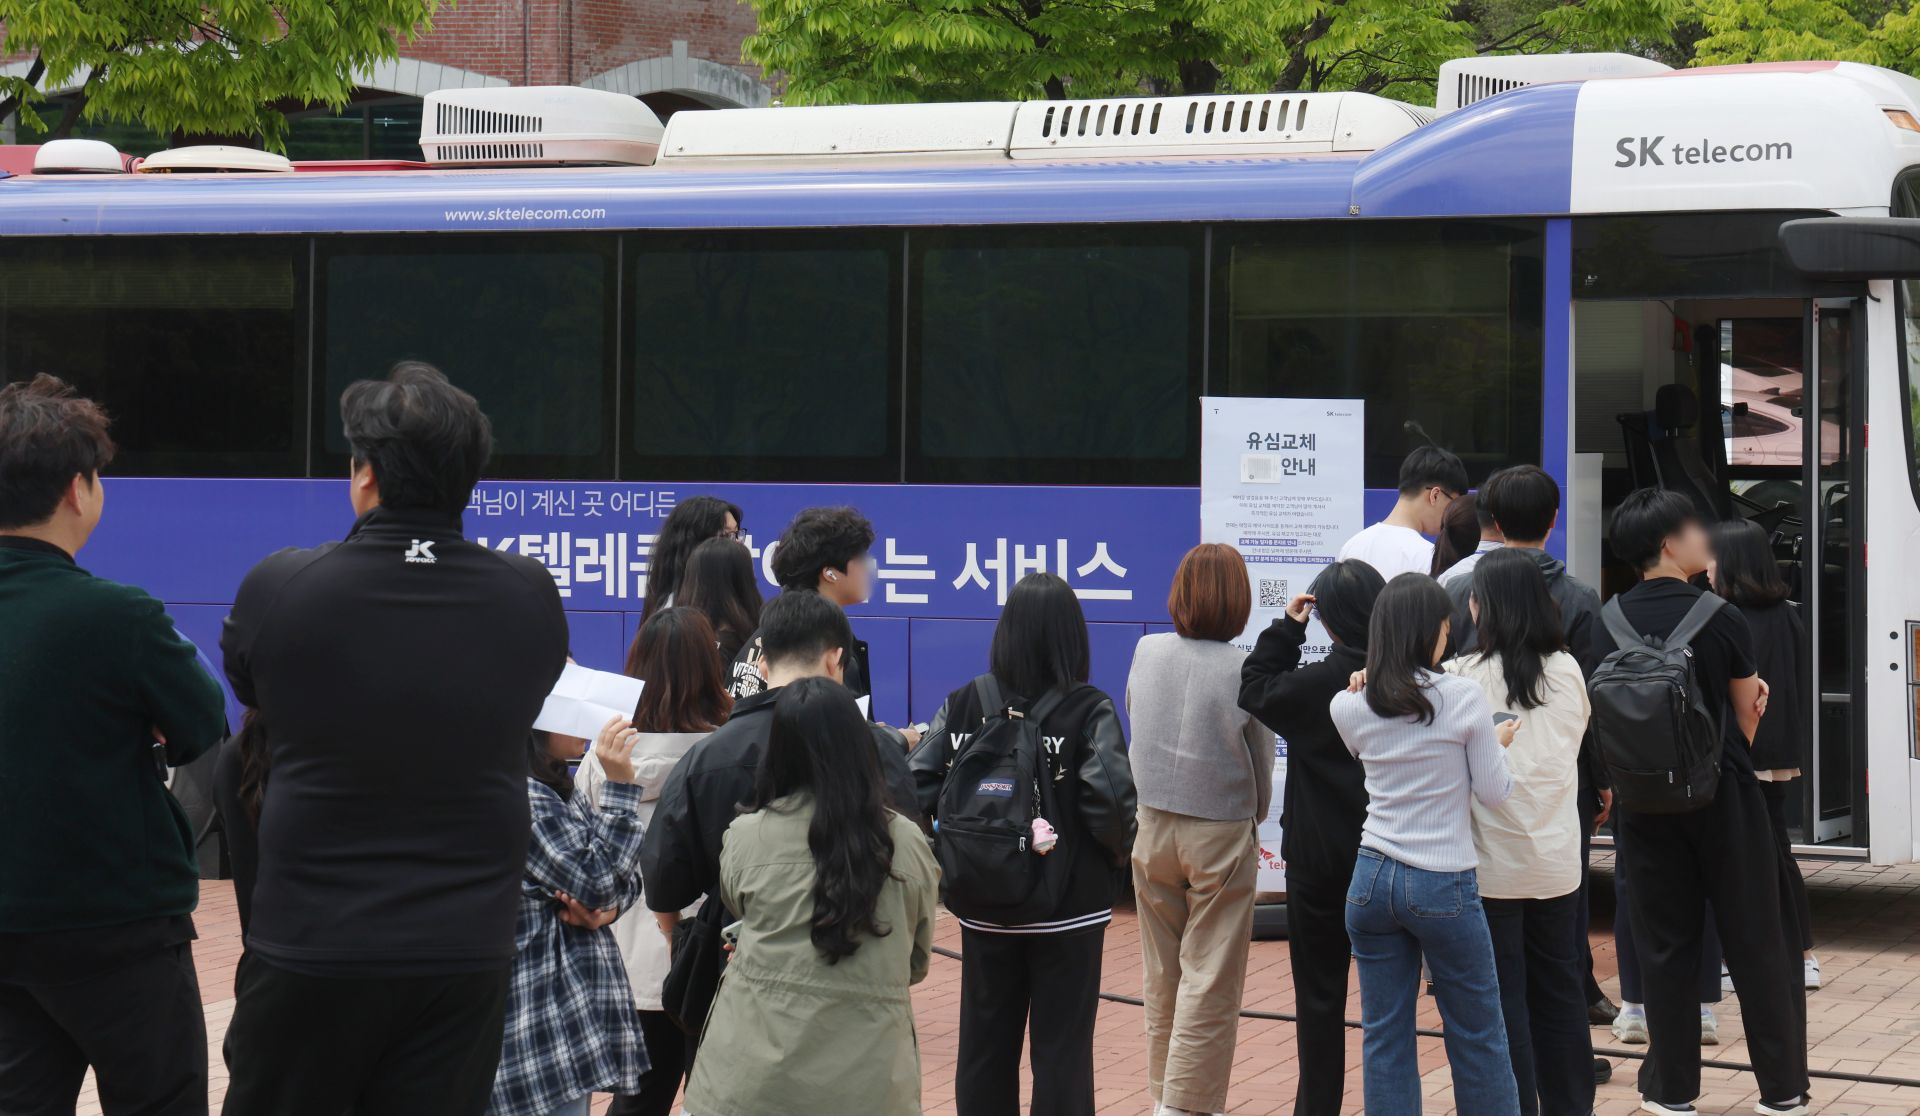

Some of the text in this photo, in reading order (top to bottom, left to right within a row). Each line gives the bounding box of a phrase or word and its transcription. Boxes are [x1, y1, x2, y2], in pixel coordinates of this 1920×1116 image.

[1615, 135, 1792, 168] SK telecom
[445, 207, 606, 221] www.sktelecom.com
[1246, 431, 1316, 451] 유심교체
[1281, 457, 1316, 476] 안내
[532, 489, 576, 517] 계신
[582, 491, 605, 517] 곳
[610, 490, 677, 518] 어디든
[952, 538, 1133, 606] 서비스
